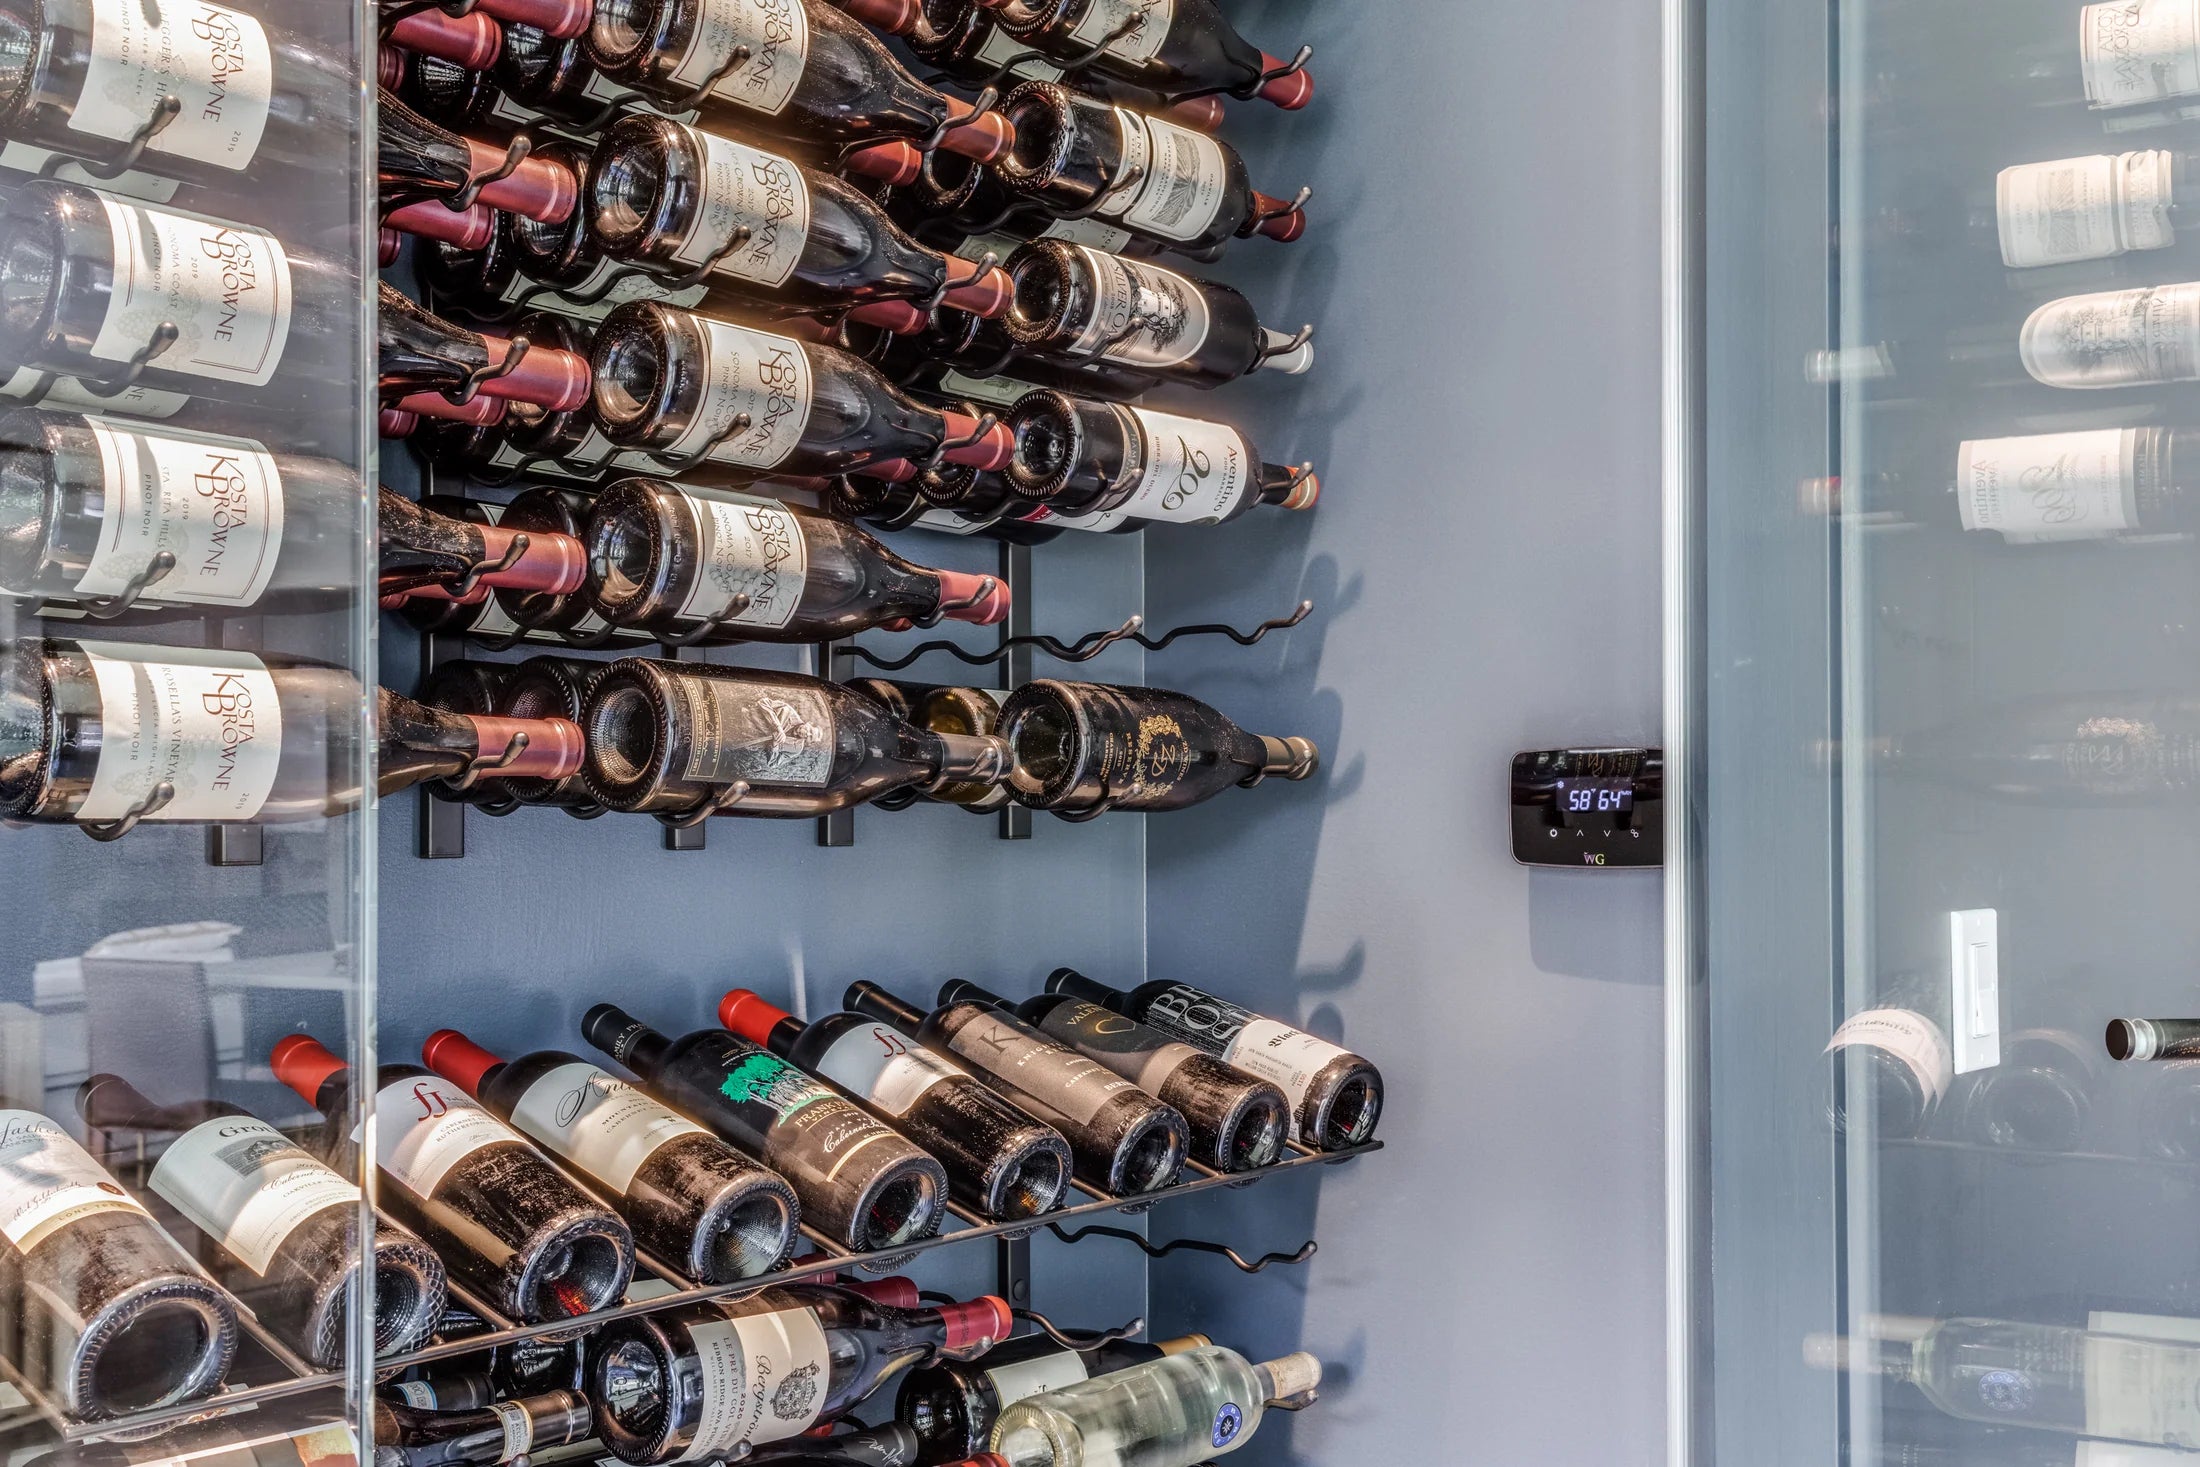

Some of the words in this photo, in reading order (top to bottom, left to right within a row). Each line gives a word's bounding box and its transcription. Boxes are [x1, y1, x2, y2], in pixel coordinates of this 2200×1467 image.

[777, 0, 793, 43] OSTA
[120, 37, 130, 66] NOIR
[200, 5, 244, 76] KOSTA
[191, 19, 234, 123] BROWNE
[226, 130, 242, 153] 2019
[714, 162, 723, 194] PINOT
[760, 154, 794, 220] KOSTA
[712, 193, 724, 219] NOIR
[748, 161, 780, 265] BROWNE
[151, 232, 161, 260] PINOT
[208, 223, 256, 293] KOSTA
[153, 265, 161, 292] NOIR
[191, 257, 199, 279] 2019
[170, 273, 181, 308] COAST
[200, 236, 242, 343] BROWNE
[1110, 263, 1128, 310] SILVER
[720, 366, 729, 395] PINOT
[731, 351, 740, 401] SONOMA
[768, 346, 797, 417] KOSTA
[741, 359, 783, 456] BROWNE
[747, 389, 756, 411] 2017
[720, 404, 736, 429] COA
[1162, 434, 1211, 511] 200
[1213, 445, 1238, 512] Aventino
[144, 473, 153, 505] PINOT
[163, 491, 172, 514] RITA
[205, 453, 248, 531] KOSTA
[141, 509, 151, 536] NOIR
[182, 497, 190, 521] 2019
[157, 519, 170, 548] HILLS
[194, 472, 233, 577] BROWNE
[714, 518, 723, 545] PINOT
[751, 502, 791, 562] KOSTA
[716, 546, 725, 574] NOIR
[743, 510, 778, 609] BROWNE
[744, 536, 753, 559] 2017
[162, 667, 182, 725] ROSELLA'S
[212, 672, 254, 745] KOSTA
[130, 731, 140, 761] NOIR
[164, 729, 181, 783] VINEYAR
[203, 692, 238, 792] BROWNE
[1182, 740, 1189, 753] ZD
[1177, 754, 1189, 780] WINES
[1598, 790, 1621, 810] 64
[977, 1024, 1023, 1055] K
[1065, 1067, 1100, 1088] CABERNET
[794, 1102, 835, 1127] FRANK
[823, 1121, 869, 1154] Cabernet
[58, 1206, 90, 1221] LONE
[723, 1337, 732, 1350] LE
[712, 1342, 725, 1376] RIBBON
[731, 1379, 739, 1394] DU
[714, 1408, 725, 1425] AVA
[728, 1398, 738, 1421] COL
[737, 1392, 747, 1420] 2020
